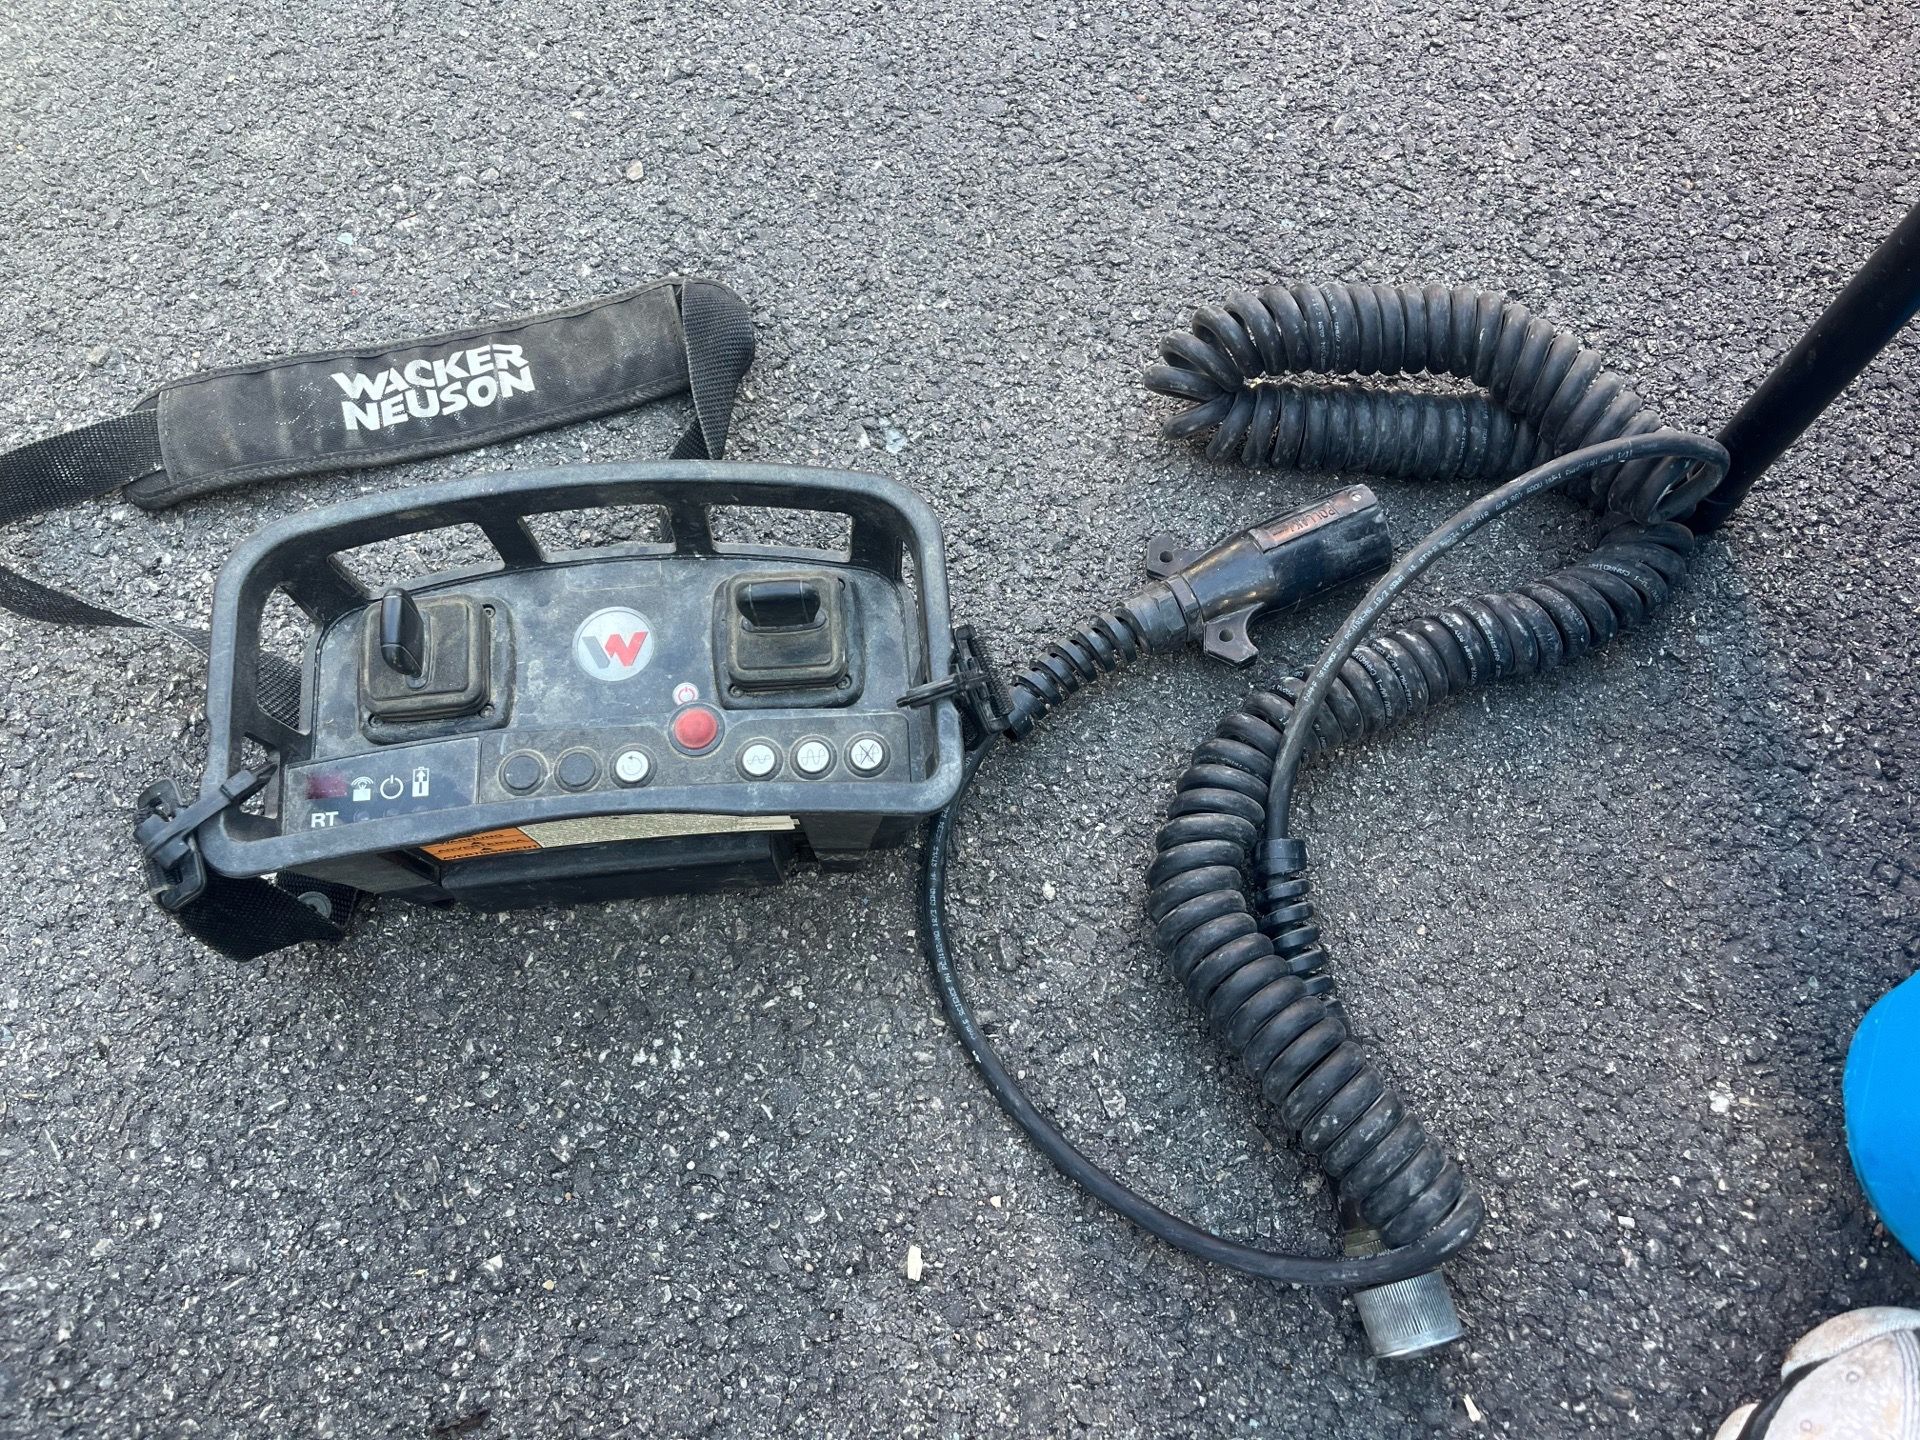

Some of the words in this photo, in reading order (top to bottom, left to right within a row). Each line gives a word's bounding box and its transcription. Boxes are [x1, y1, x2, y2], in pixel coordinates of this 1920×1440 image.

[331, 344, 529, 400] WACKER
[341, 366, 536, 431] NEUSON
[1290, 505, 1338, 532] POLLAK
[311, 811, 339, 828] RT
